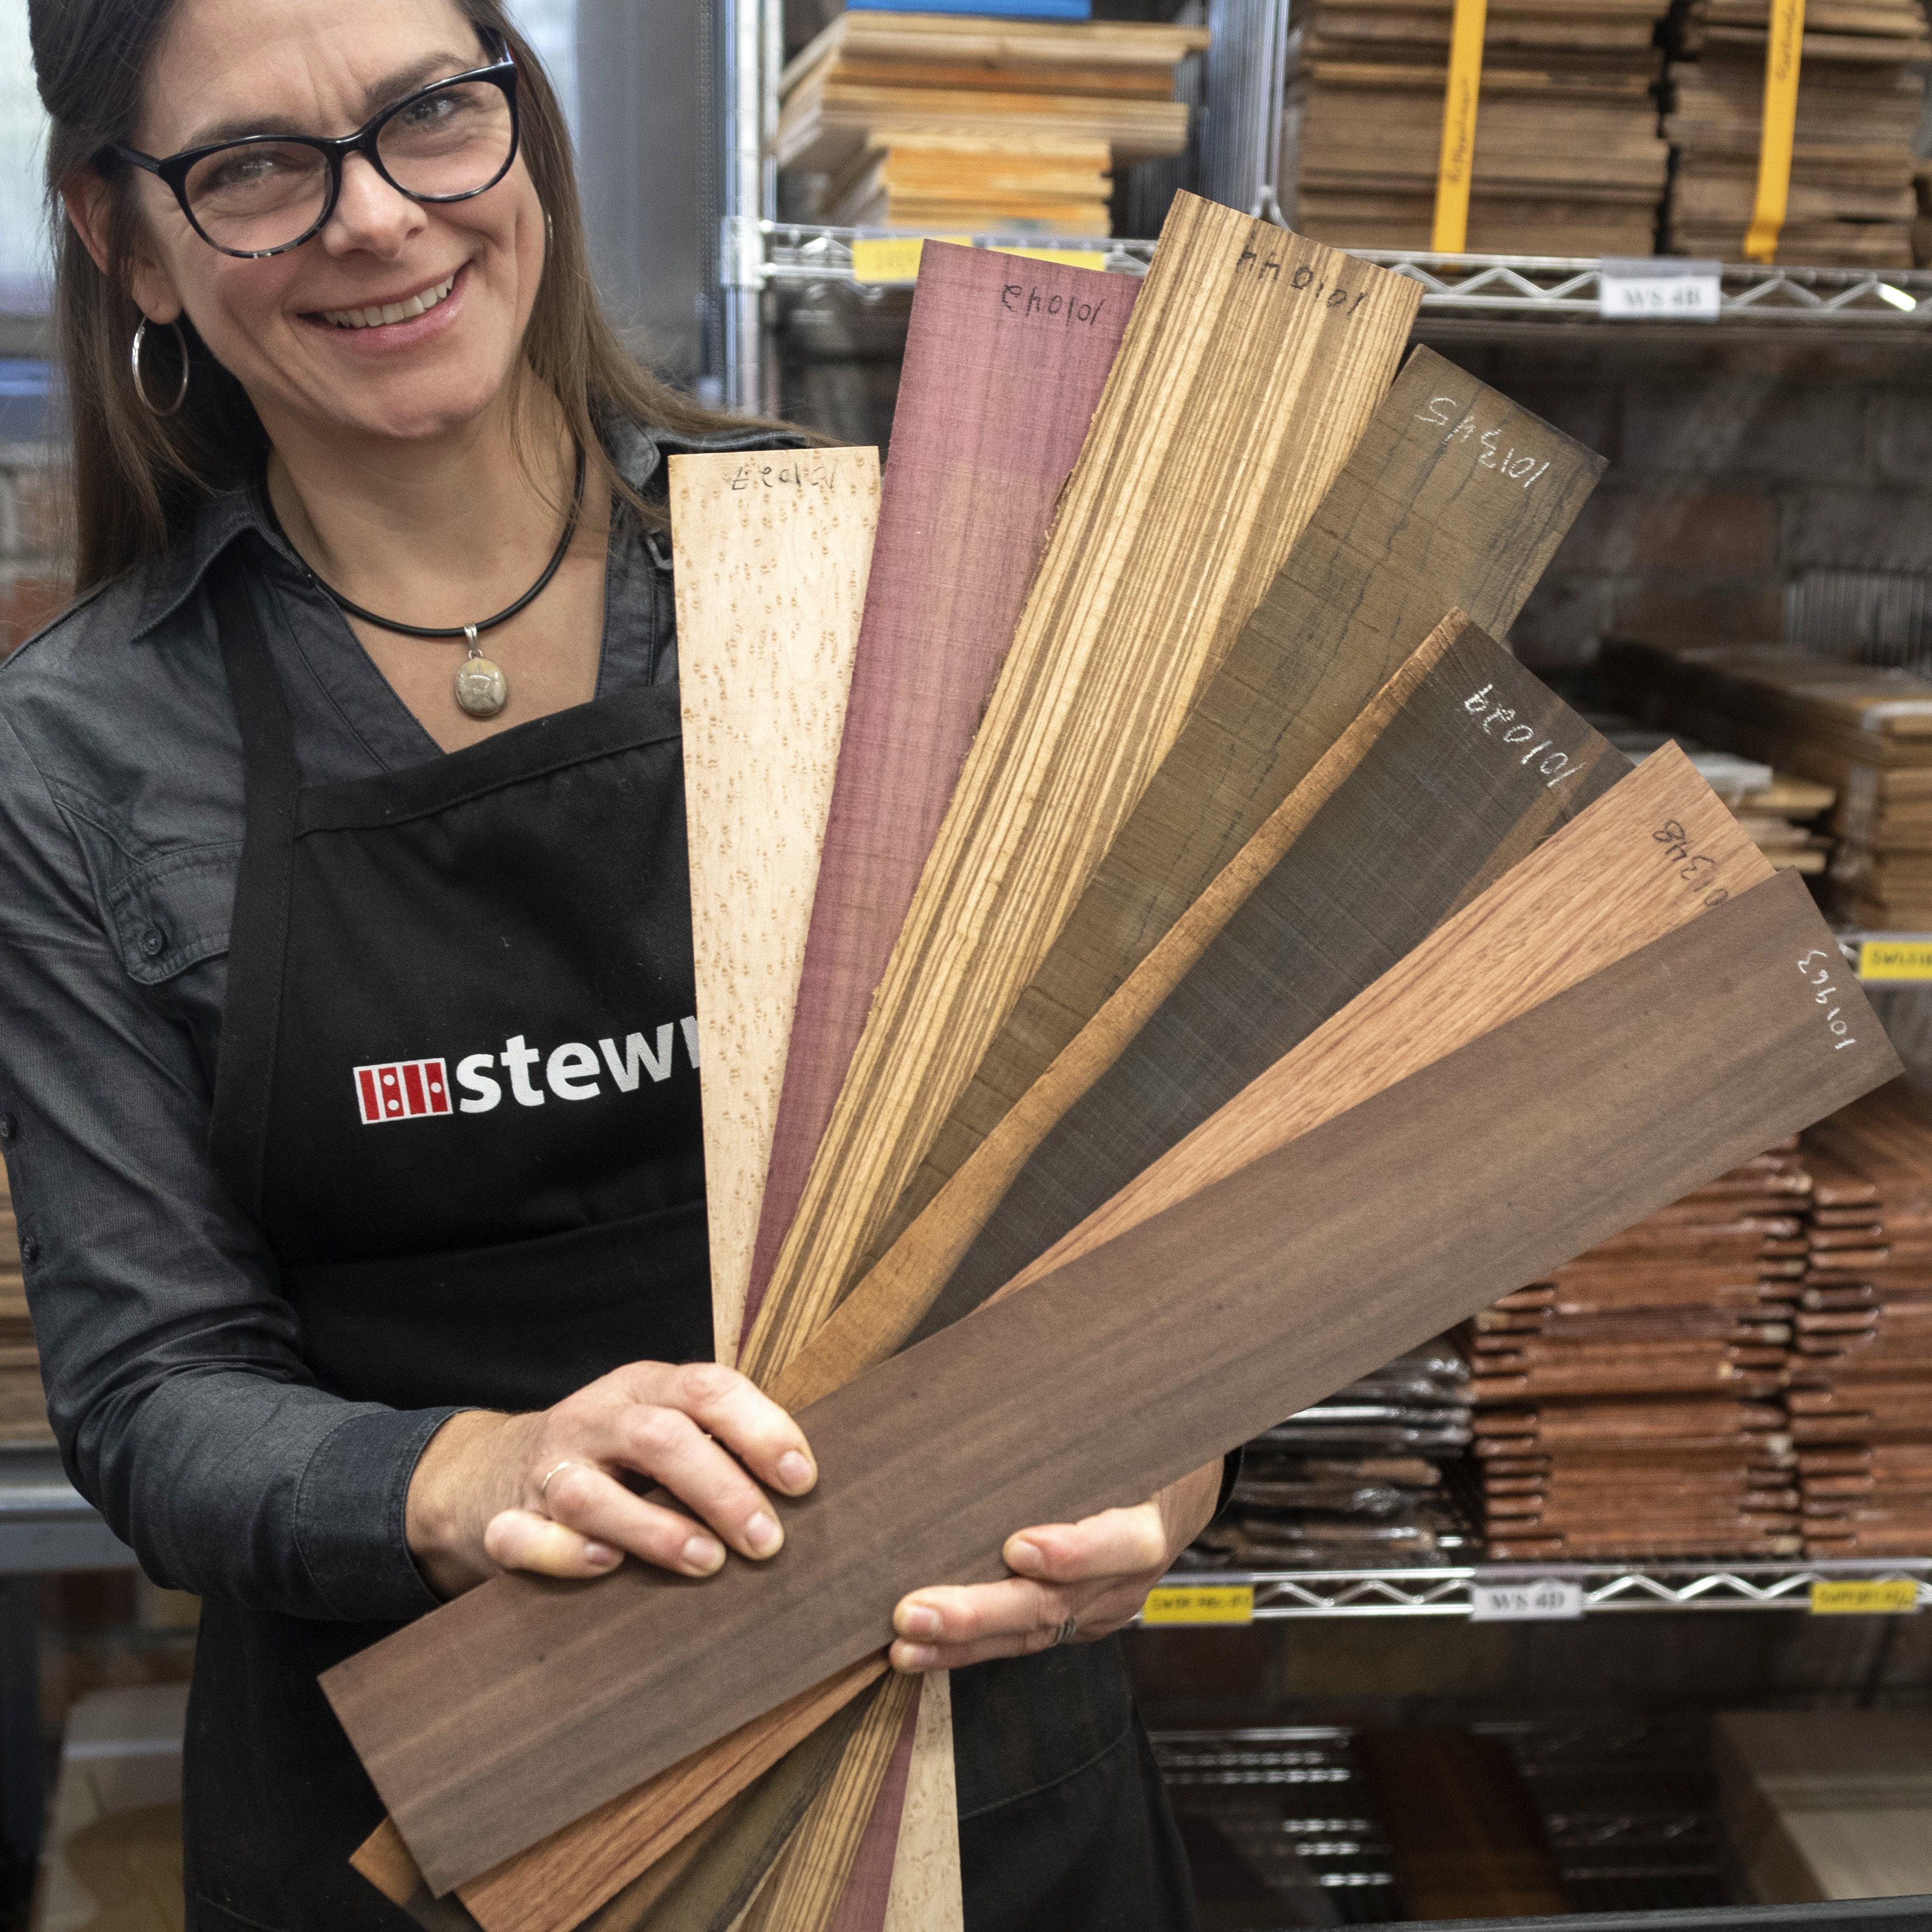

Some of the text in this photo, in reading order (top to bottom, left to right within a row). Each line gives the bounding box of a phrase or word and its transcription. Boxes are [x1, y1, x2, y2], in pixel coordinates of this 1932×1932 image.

[1001, 284, 1105, 325] 101042
[1235, 231, 1366, 317] 101044
[1416, 397, 1550, 487] 101345
[1652, 822, 1728, 907] 01348
[1797, 949, 1855, 1049] 101963
